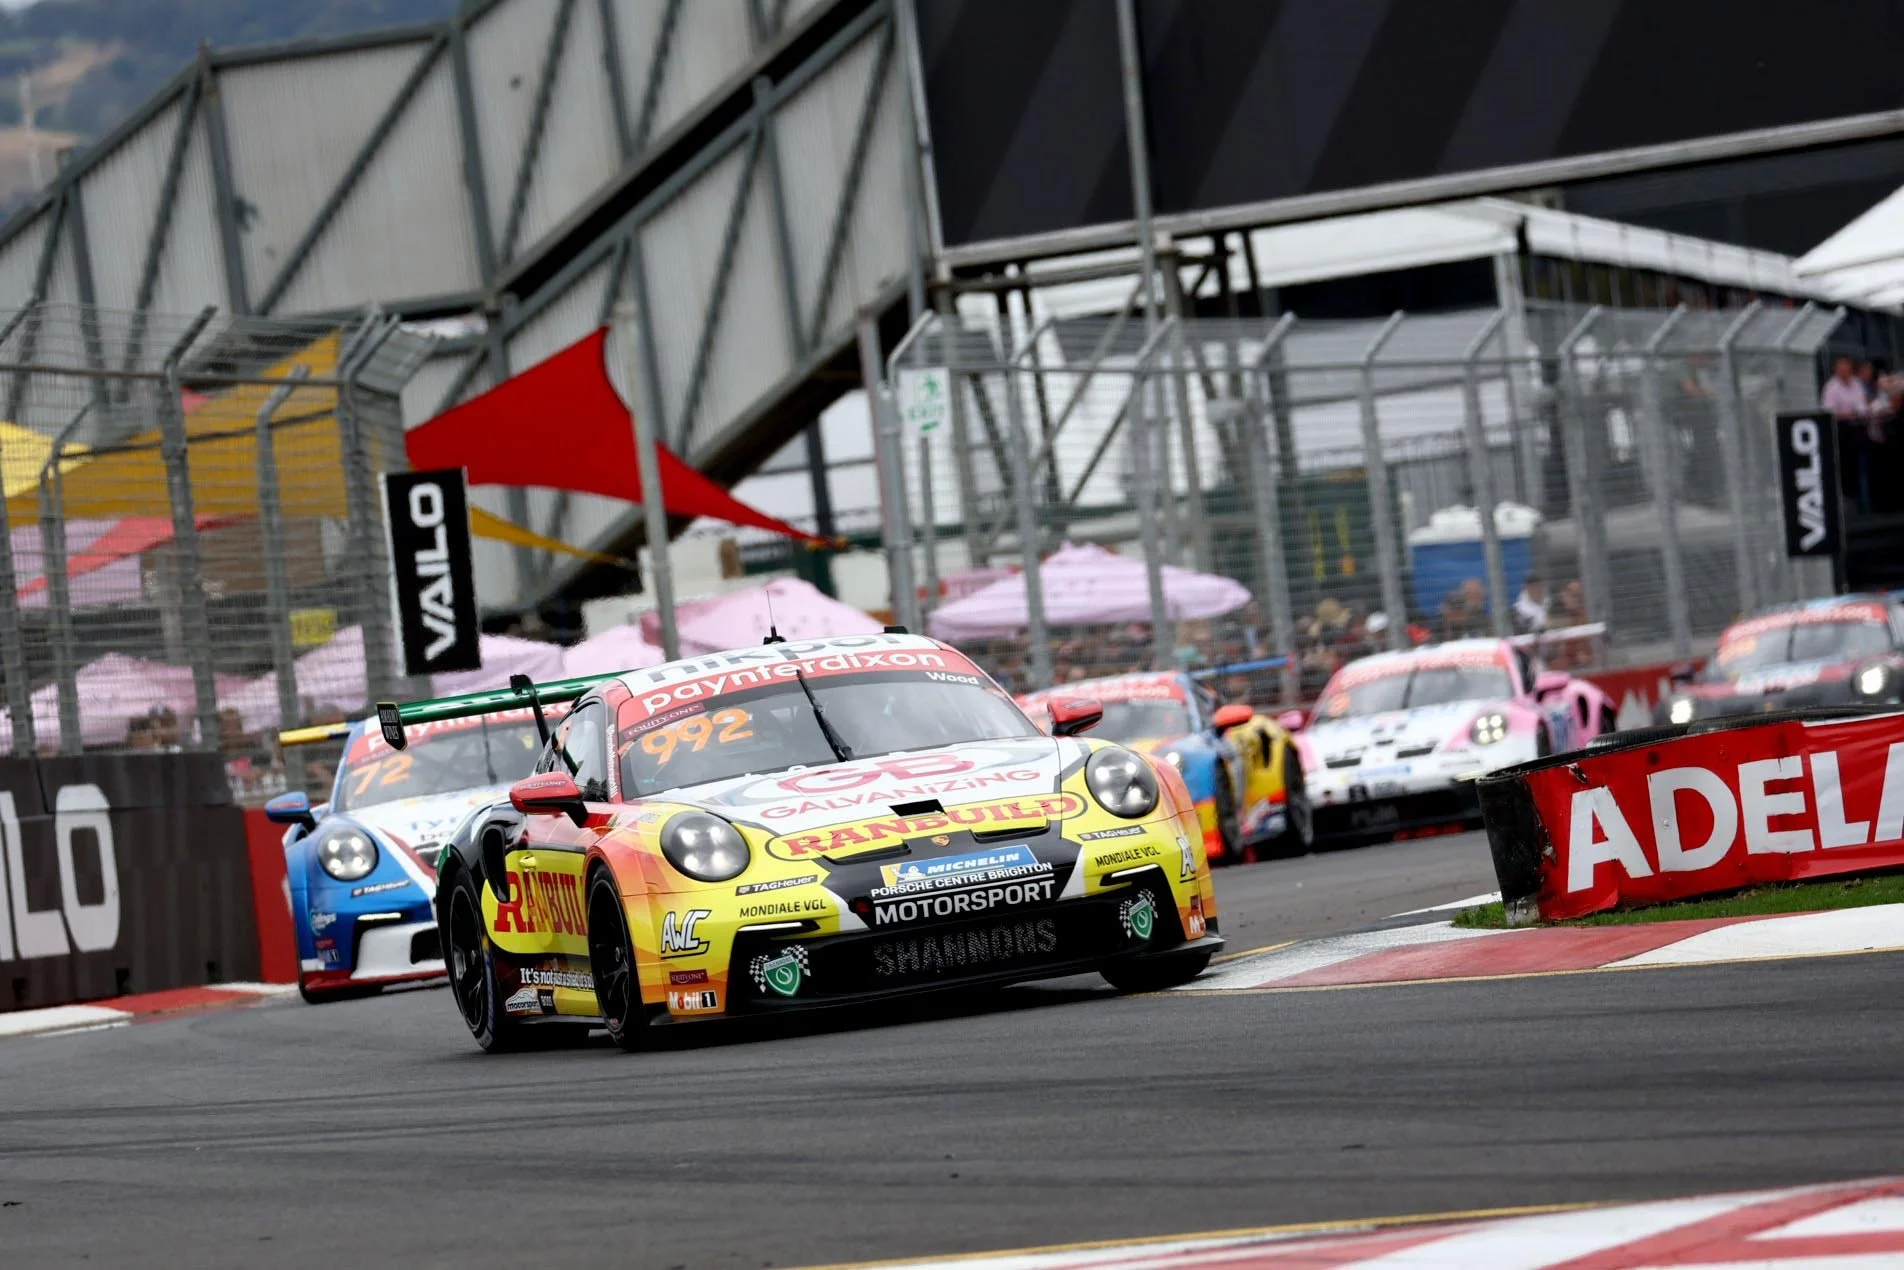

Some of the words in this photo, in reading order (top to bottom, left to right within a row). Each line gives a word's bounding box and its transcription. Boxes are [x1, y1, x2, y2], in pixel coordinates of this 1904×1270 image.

[1791, 418, 1827, 552] VAILO
[408, 481, 457, 662] VAILO
[643, 650, 945, 716] paynterdixon
[925, 671, 979, 686] Wood
[642, 708, 753, 765] 992
[352, 754, 415, 796] 72
[776, 754, 975, 793] GB
[783, 796, 1078, 856] RANBUILD
[927, 853, 1020, 874] MICHELIN
[1094, 847, 1143, 868] MONDIALE
[1140, 845, 1161, 857] VGL
[871, 881, 933, 897] PORSCHE
[935, 872, 987, 888] CENTRE
[988, 862, 1053, 879] BRIGHTON
[494, 871, 588, 937] RANBUI
[739, 901, 801, 918] MONDIALE
[803, 898, 827, 911] VGL
[875, 880, 1056, 925] MOTORSPORT
[873, 918, 1057, 976] SHANNONS
[520, 967, 540, 985] It's
[541, 970, 554, 986] not
[669, 991, 701, 1010] Mobil
